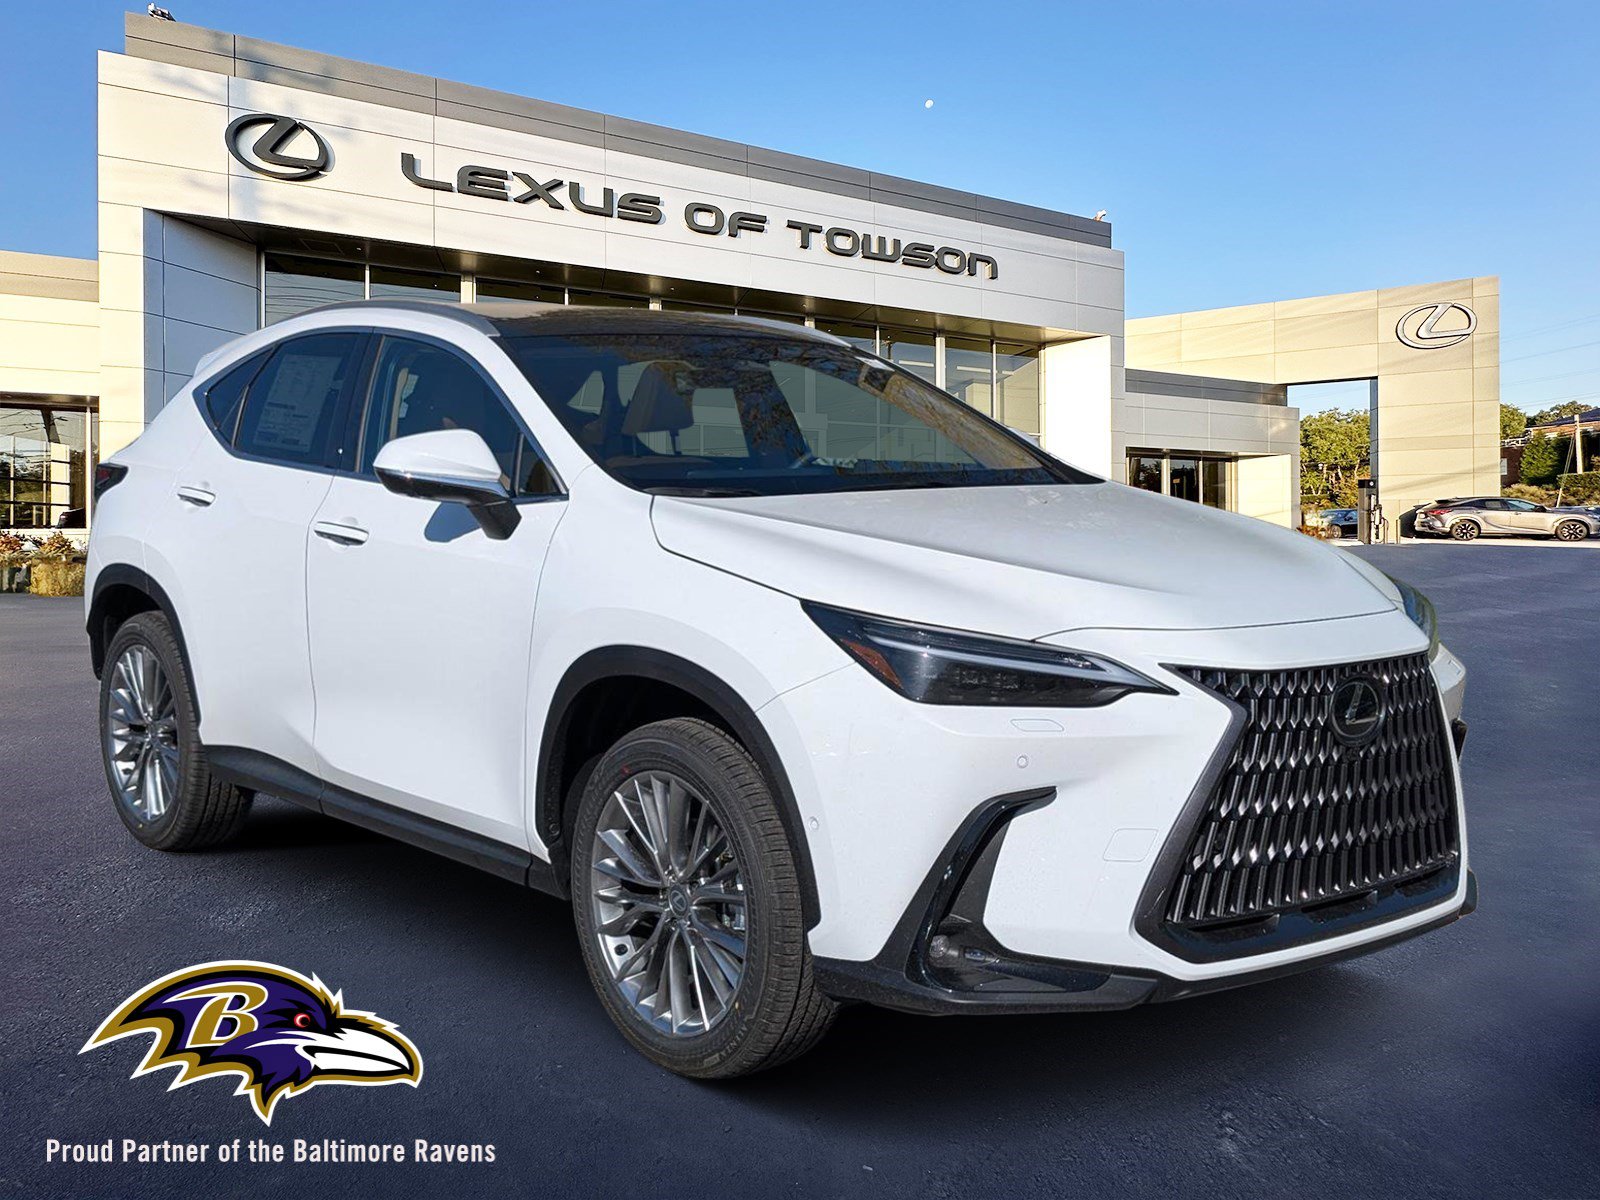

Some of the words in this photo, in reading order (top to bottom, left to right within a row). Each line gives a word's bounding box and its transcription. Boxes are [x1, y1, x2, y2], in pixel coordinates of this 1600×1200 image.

[401, 152, 663, 225] LEXUS
[684, 202, 767, 238] OF
[786, 219, 998, 280] TOWSON
